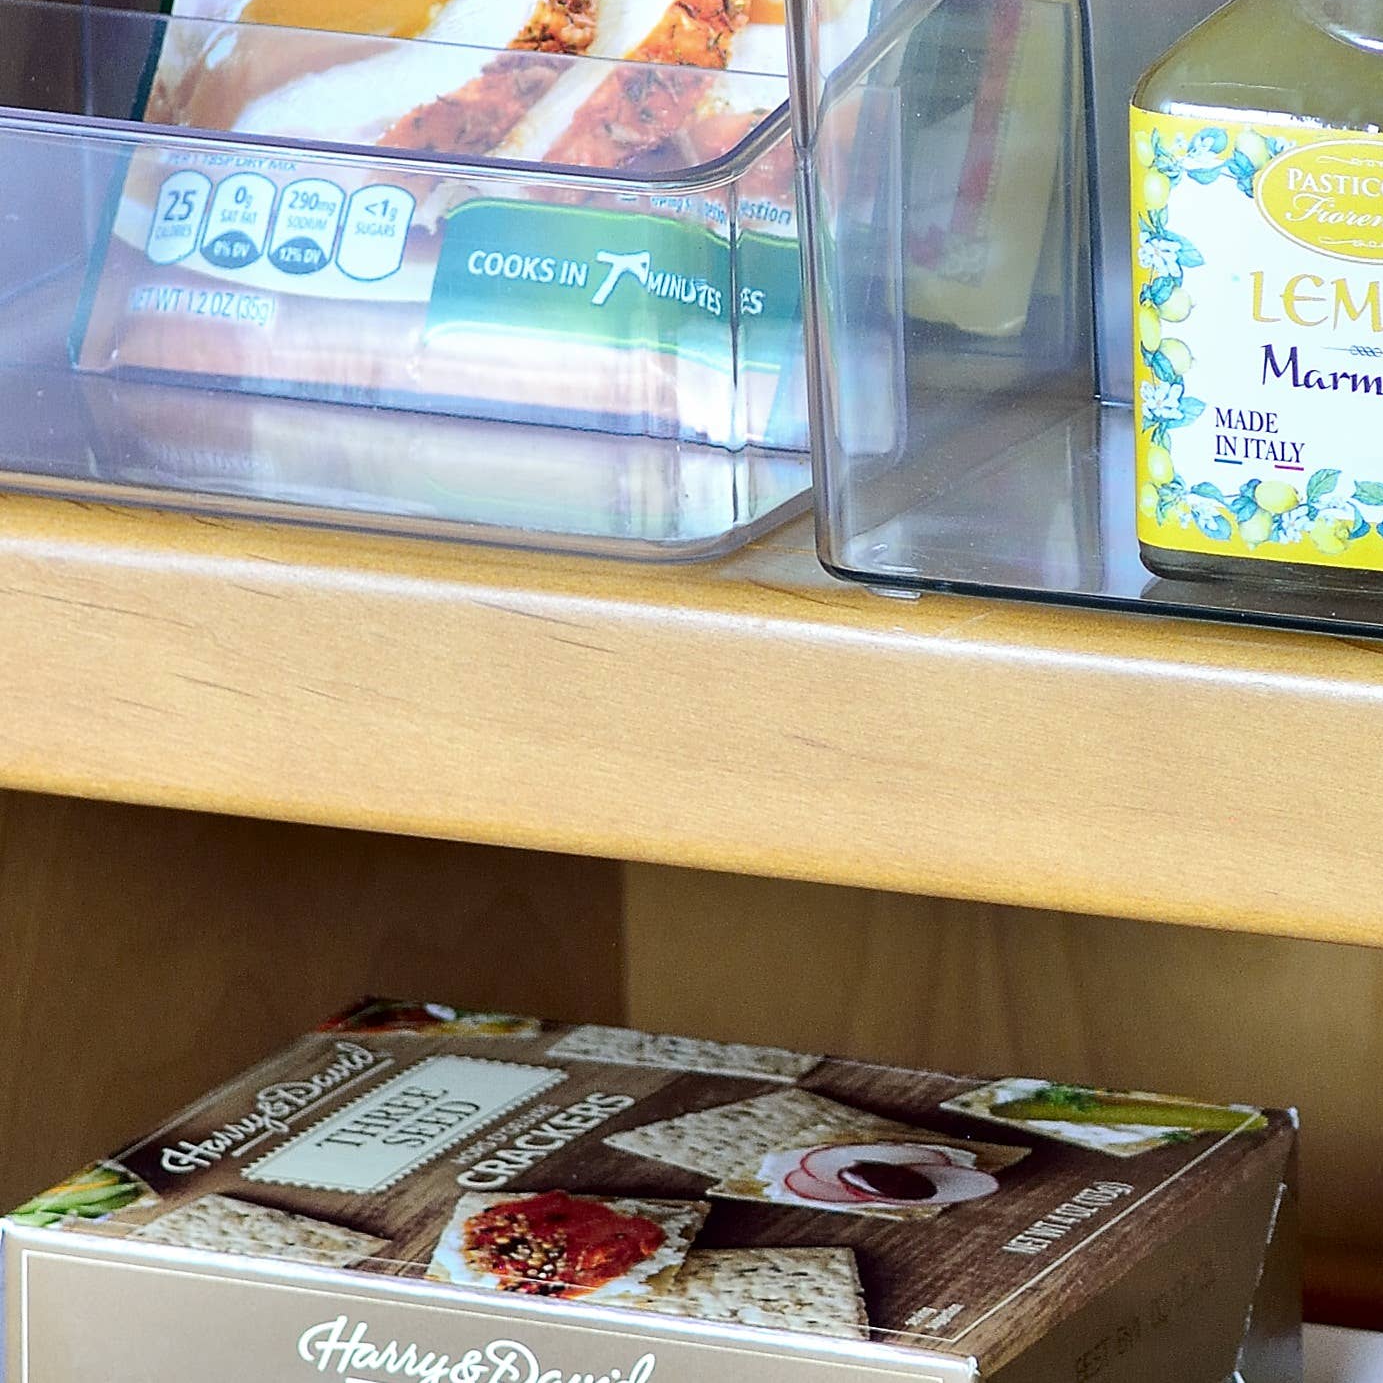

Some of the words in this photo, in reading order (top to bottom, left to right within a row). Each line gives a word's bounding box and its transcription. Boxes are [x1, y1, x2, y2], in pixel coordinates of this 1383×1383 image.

[163, 190, 196, 221] 25
[288, 190, 336, 215] 290mg
[287, 216, 329, 231] SODIUM
[354, 222, 396, 237] SUGARS
[231, 241, 251, 259] DV
[303, 247, 322, 265] DV
[468, 250, 556, 284] COOKS
[559, 260, 588, 288] IN
[591, 250, 650, 306] 7
[210, 292, 235, 317] OZ
[1214, 406, 1278, 434] MADE
[1214, 434, 1238, 457] IN
[1243, 437, 1306, 464] ITALY
[315, 1084, 450, 1149] THREE
[382, 1099, 481, 1149] SEED
[456, 1090, 637, 1191] CRACKERS
